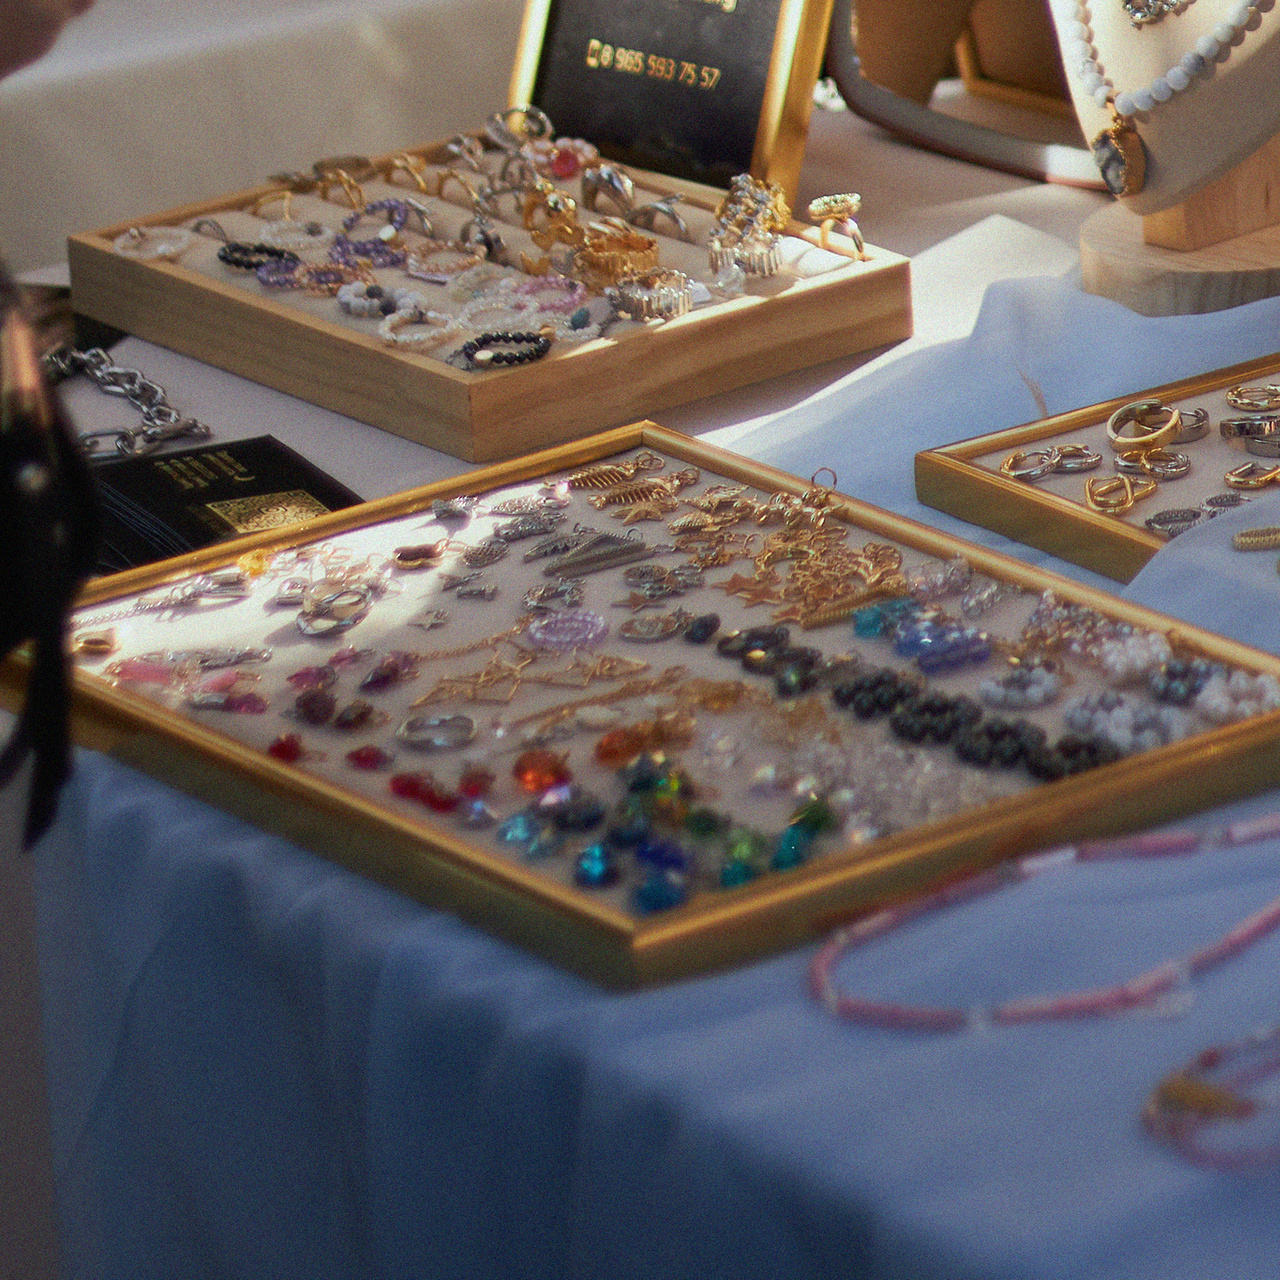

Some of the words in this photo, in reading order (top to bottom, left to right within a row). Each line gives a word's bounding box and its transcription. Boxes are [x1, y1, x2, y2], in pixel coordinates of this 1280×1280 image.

[600, 43, 614, 69] 8
[615, 47, 645, 75] 965
[679, 61, 698, 86] 75
[700, 66, 721, 90] 57
